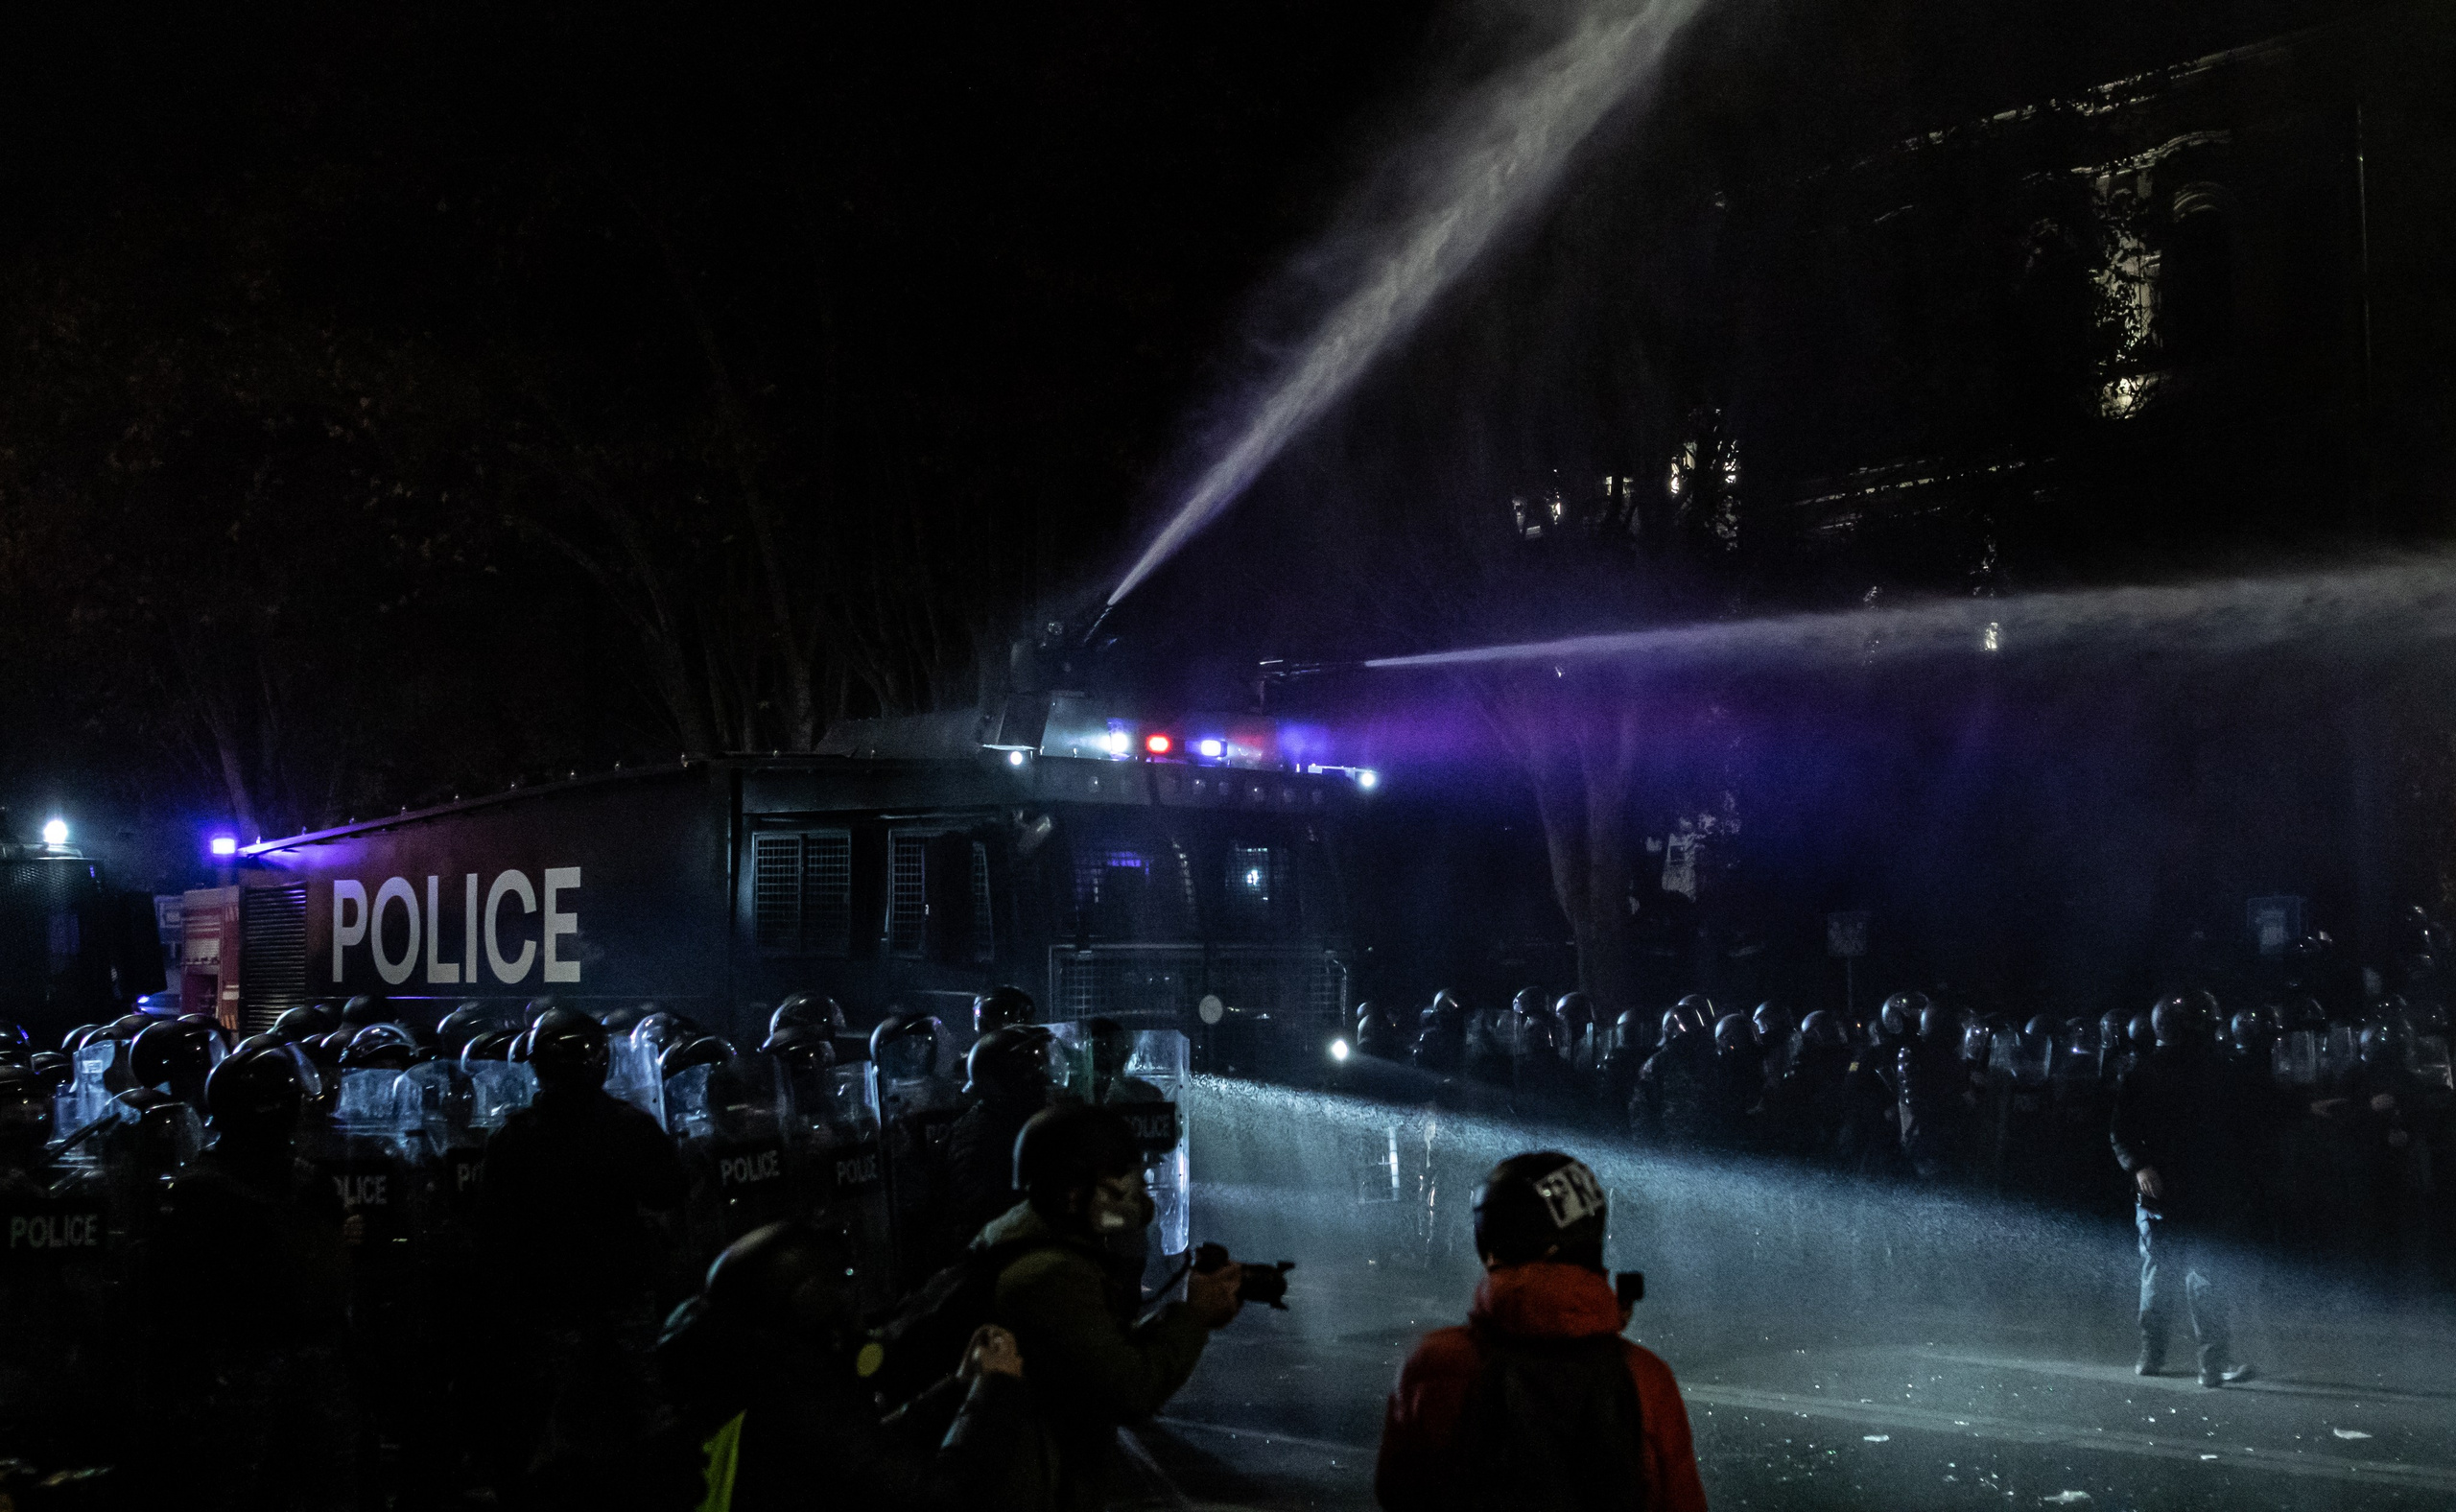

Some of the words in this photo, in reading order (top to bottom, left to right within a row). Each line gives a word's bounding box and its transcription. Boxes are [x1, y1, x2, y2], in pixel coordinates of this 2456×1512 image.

[333, 866, 581, 985] POLICE
[1122, 1114, 1170, 1139] OLICE
[720, 1150, 780, 1187] POLICE
[10, 1214, 99, 1248] POLICE
